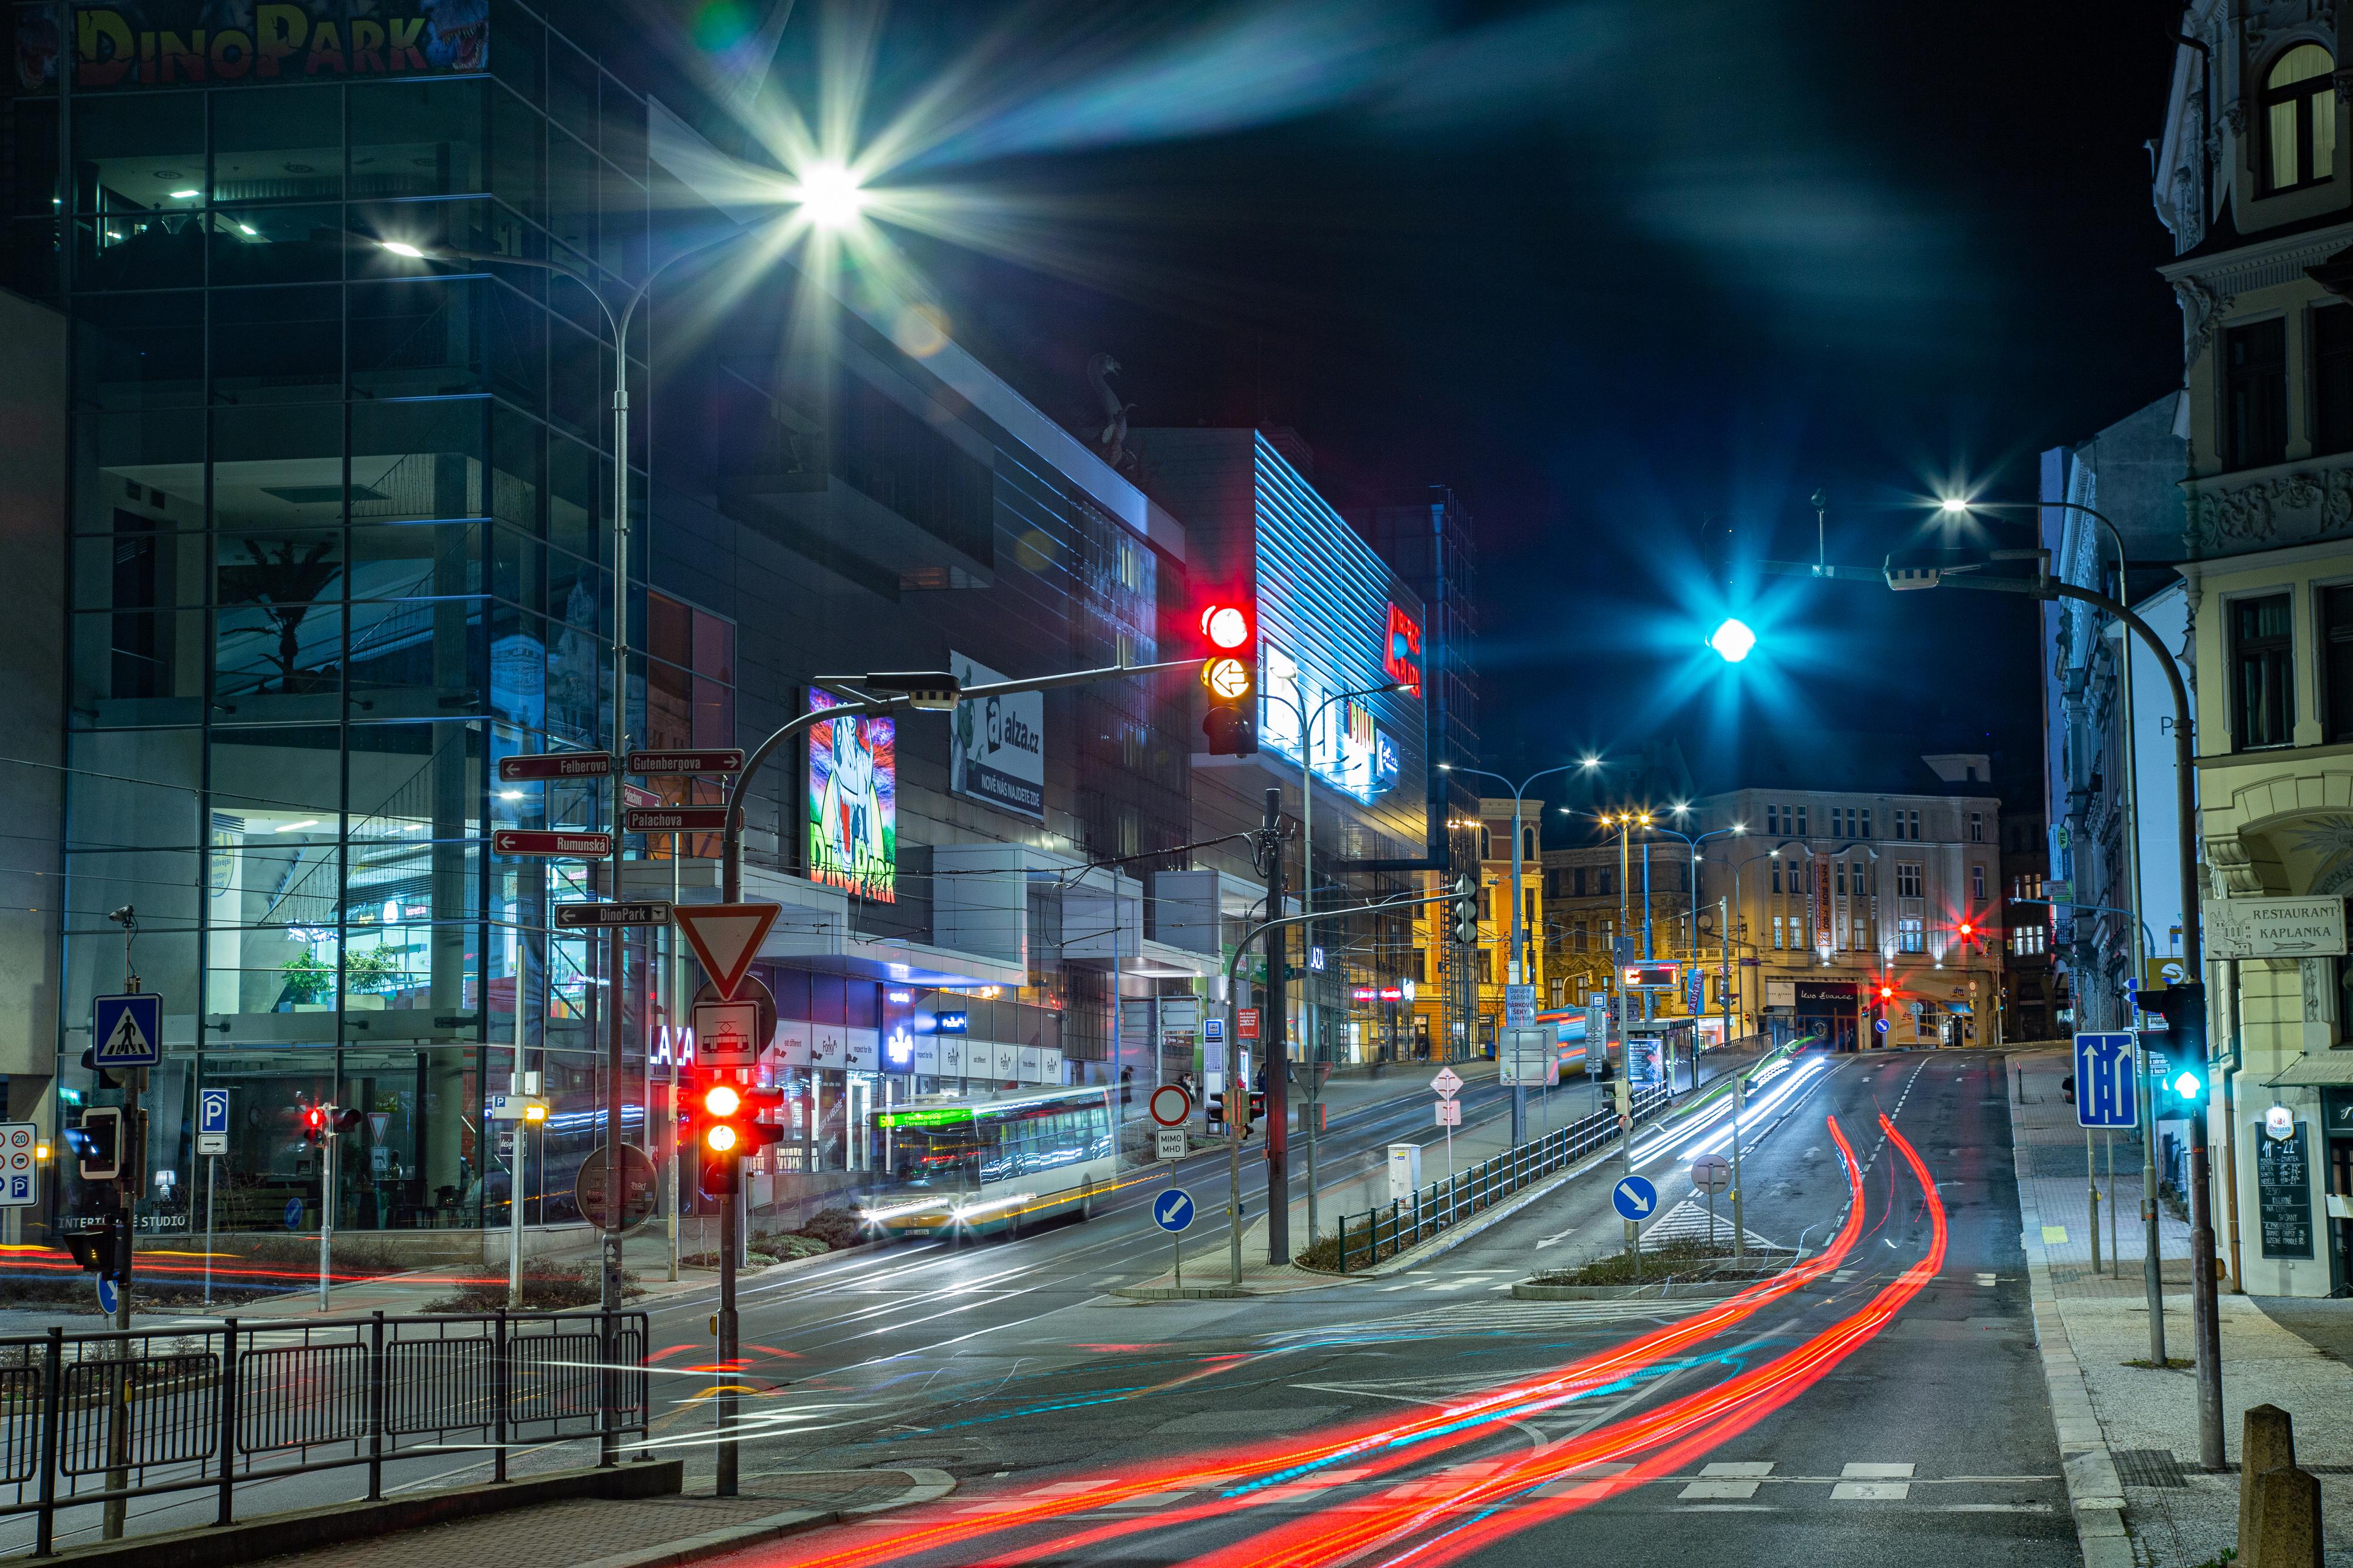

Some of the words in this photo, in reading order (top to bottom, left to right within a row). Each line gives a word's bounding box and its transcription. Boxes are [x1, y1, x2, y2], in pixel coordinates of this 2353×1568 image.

[1005, 711, 1039, 754] alza.cz
[561, 759, 606, 773] Felberova
[634, 756, 701, 771] Gutenbergova
[624, 788, 642, 806] Palachova
[981, 773, 996, 793] NOVĚ
[996, 778, 1007, 796] NÁS
[1008, 784, 1029, 804] NAJDETE
[1030, 793, 1039, 807] ZDE
[632, 813, 682, 826] Palachova
[557, 838, 605, 852] Rumunská
[600, 908, 645, 922] DinoPark
[2253, 906, 2337, 920] RESTAURANT
[2259, 926, 2332, 939] KAPLANKA
[1688, 969, 1704, 1015] BAUHAUS
[789, 1039, 802, 1047] different
[854, 1046, 864, 1055] respect
[15, 1135, 26, 1143] 20
[1161, 1135, 1182, 1143] MIMO
[1162, 1145, 1181, 1153] MHD
[141, 1216, 185, 1227] STUDIO
